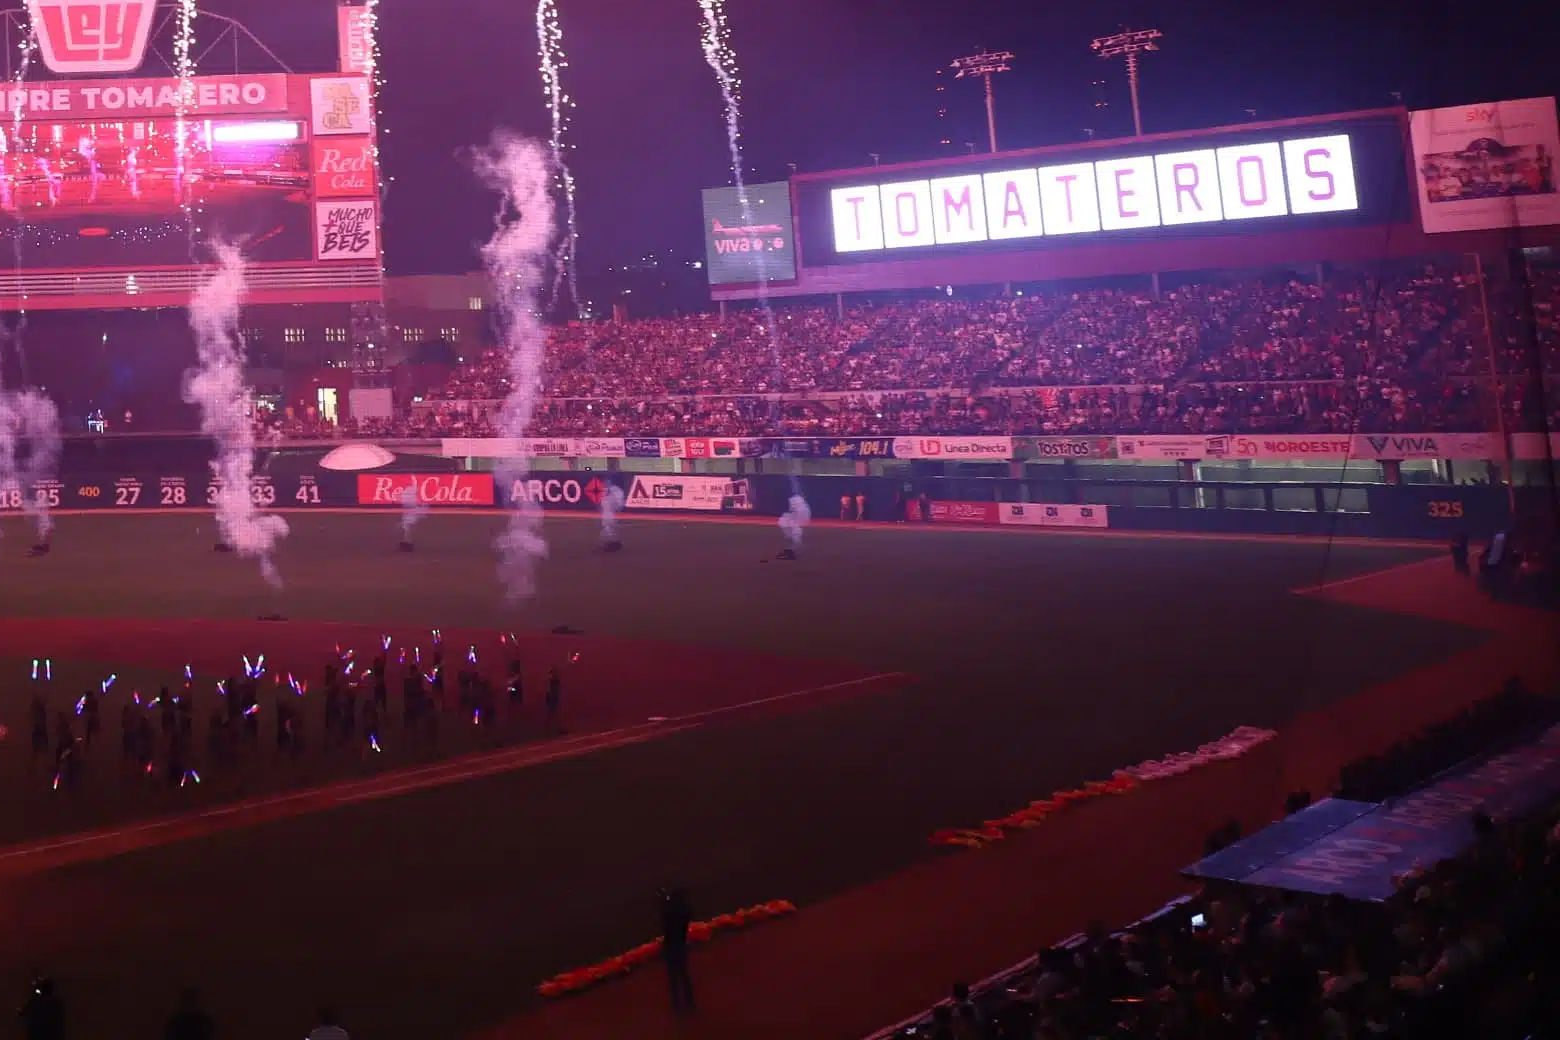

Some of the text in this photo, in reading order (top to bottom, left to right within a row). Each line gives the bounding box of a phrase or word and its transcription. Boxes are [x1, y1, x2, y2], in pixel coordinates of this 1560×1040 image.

[80, 82, 266, 111] TOMAERO
[316, 146, 368, 173] Red
[331, 173, 365, 189] Cola
[845, 148, 1336, 242] TOMATEROS
[328, 207, 373, 223] MUCHO
[337, 221, 365, 234] QUE
[321, 231, 371, 254] BEIS
[859, 440, 889, 456] 104.1
[971, 443, 1007, 454] Directa
[1265, 441, 1350, 453] NOROESTE
[1391, 437, 1438, 452] VIVA
[77, 486, 100, 497] 400
[115, 487, 141, 505] 27
[160, 486, 186, 504] 28
[251, 486, 275, 504] 33
[295, 486, 321, 503] 41
[419, 475, 473, 502] Cola
[510, 479, 581, 503] ARCO
[0, 489, 23, 508] 18
[1428, 500, 1464, 518] 325
